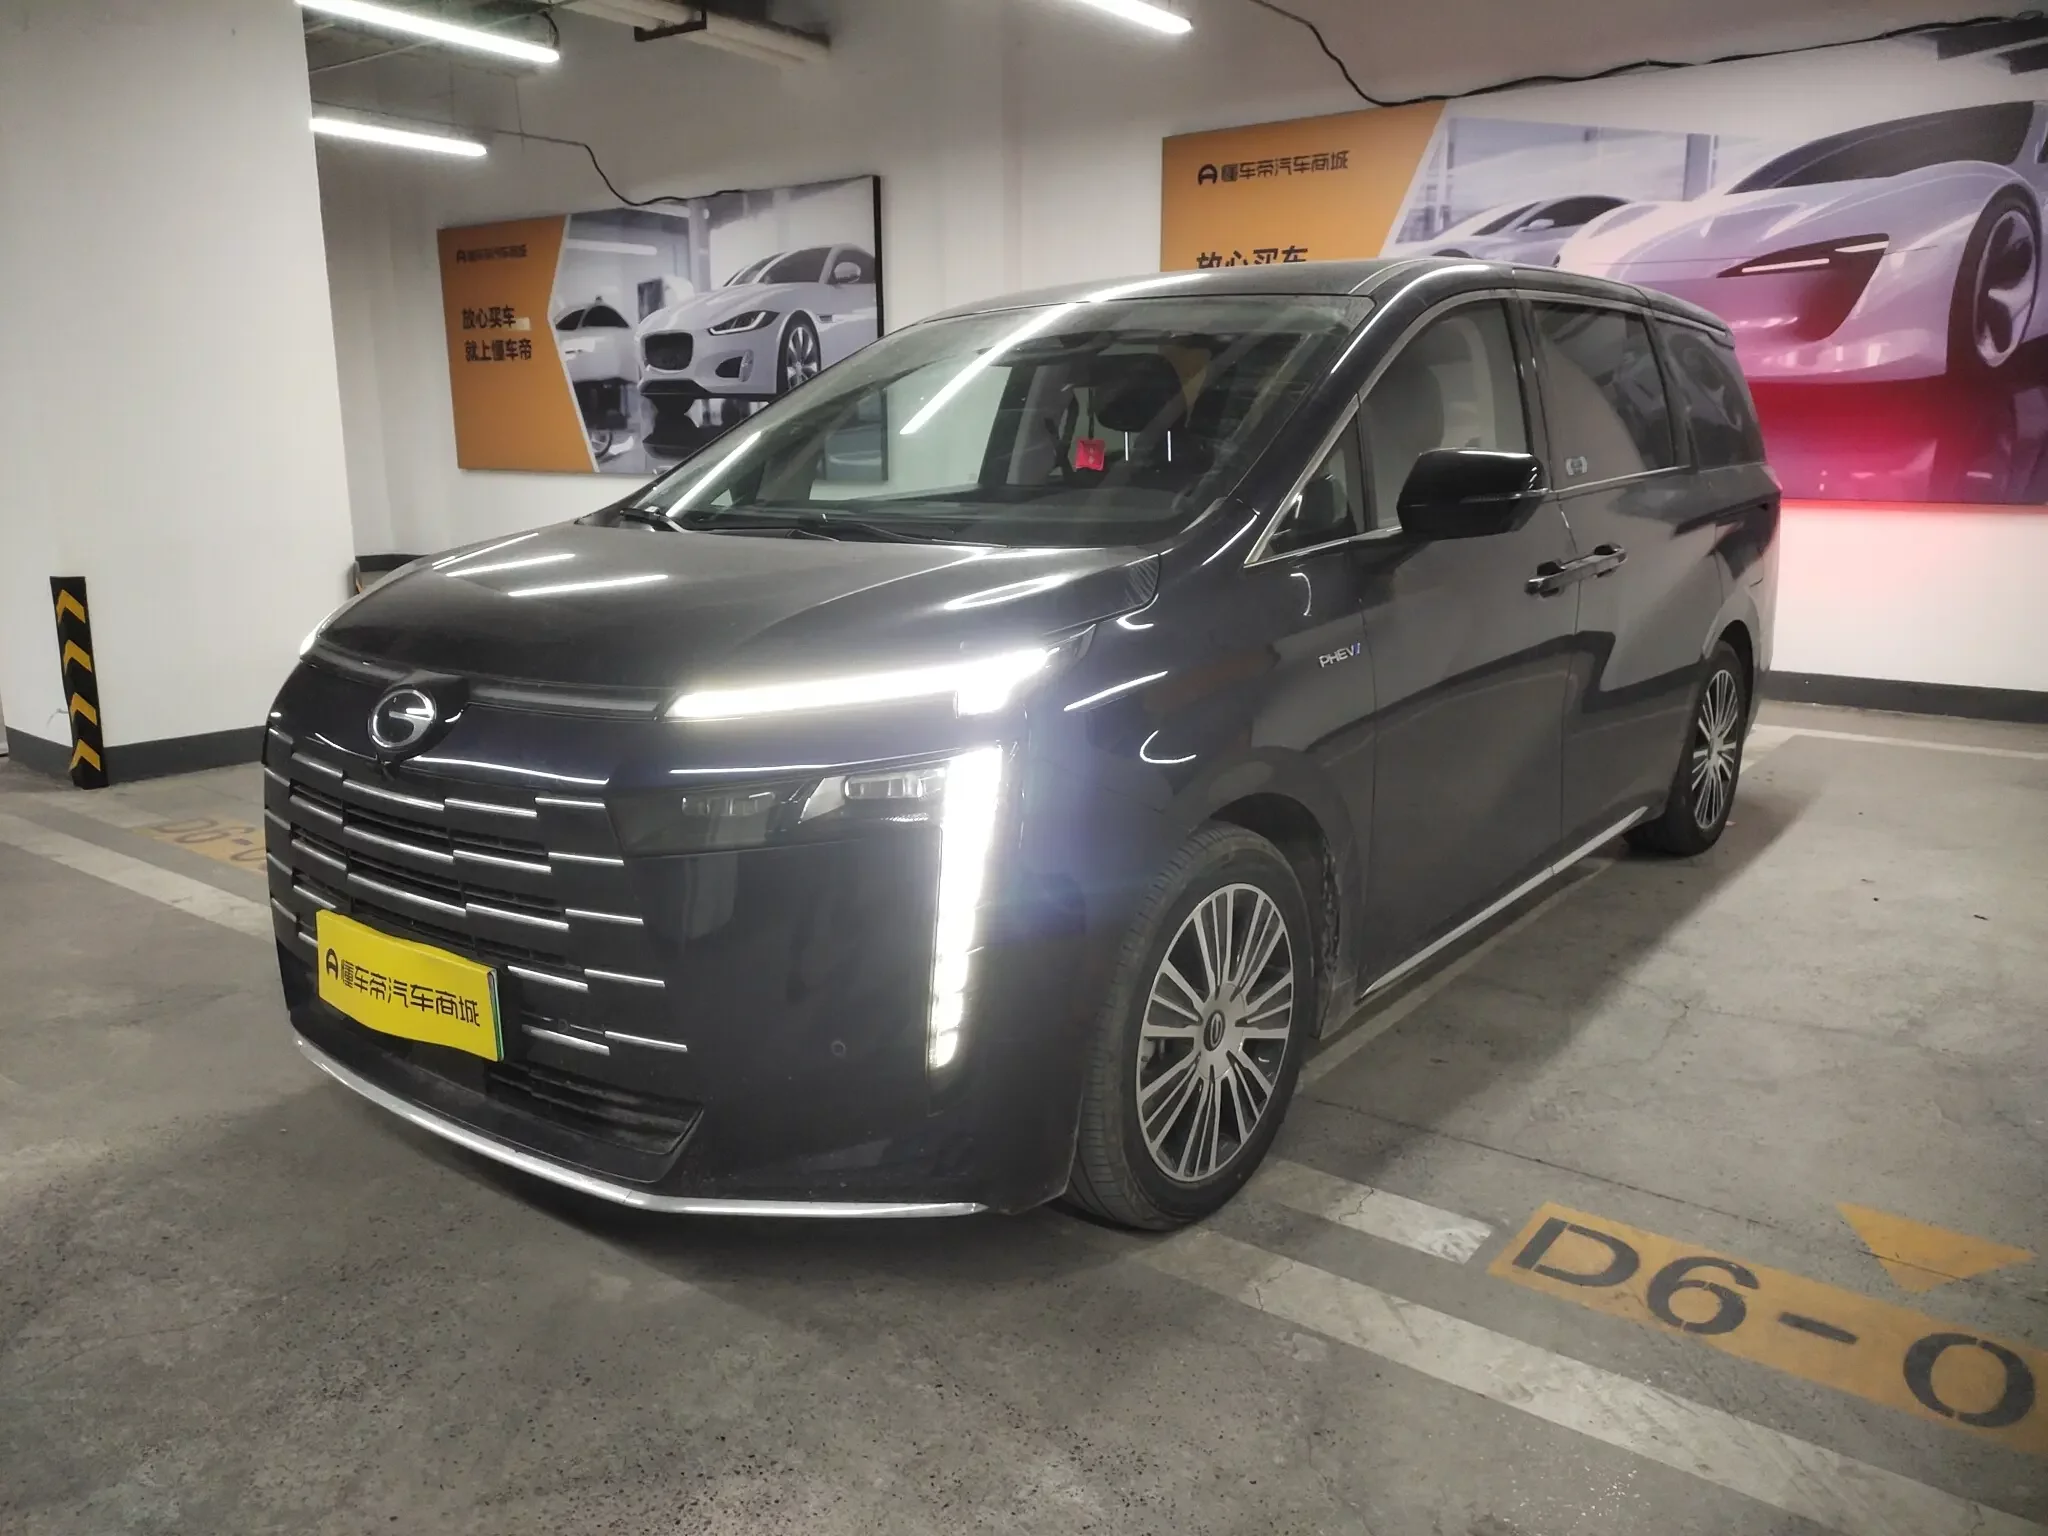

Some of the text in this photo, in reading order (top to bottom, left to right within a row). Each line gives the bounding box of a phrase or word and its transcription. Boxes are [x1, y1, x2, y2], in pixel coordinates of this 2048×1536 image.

[1221, 150, 1350, 183] 车帝汽车商城
[462, 304, 517, 330] 放心买车
[340, 959, 480, 1027] 懂车帝汽车商城
